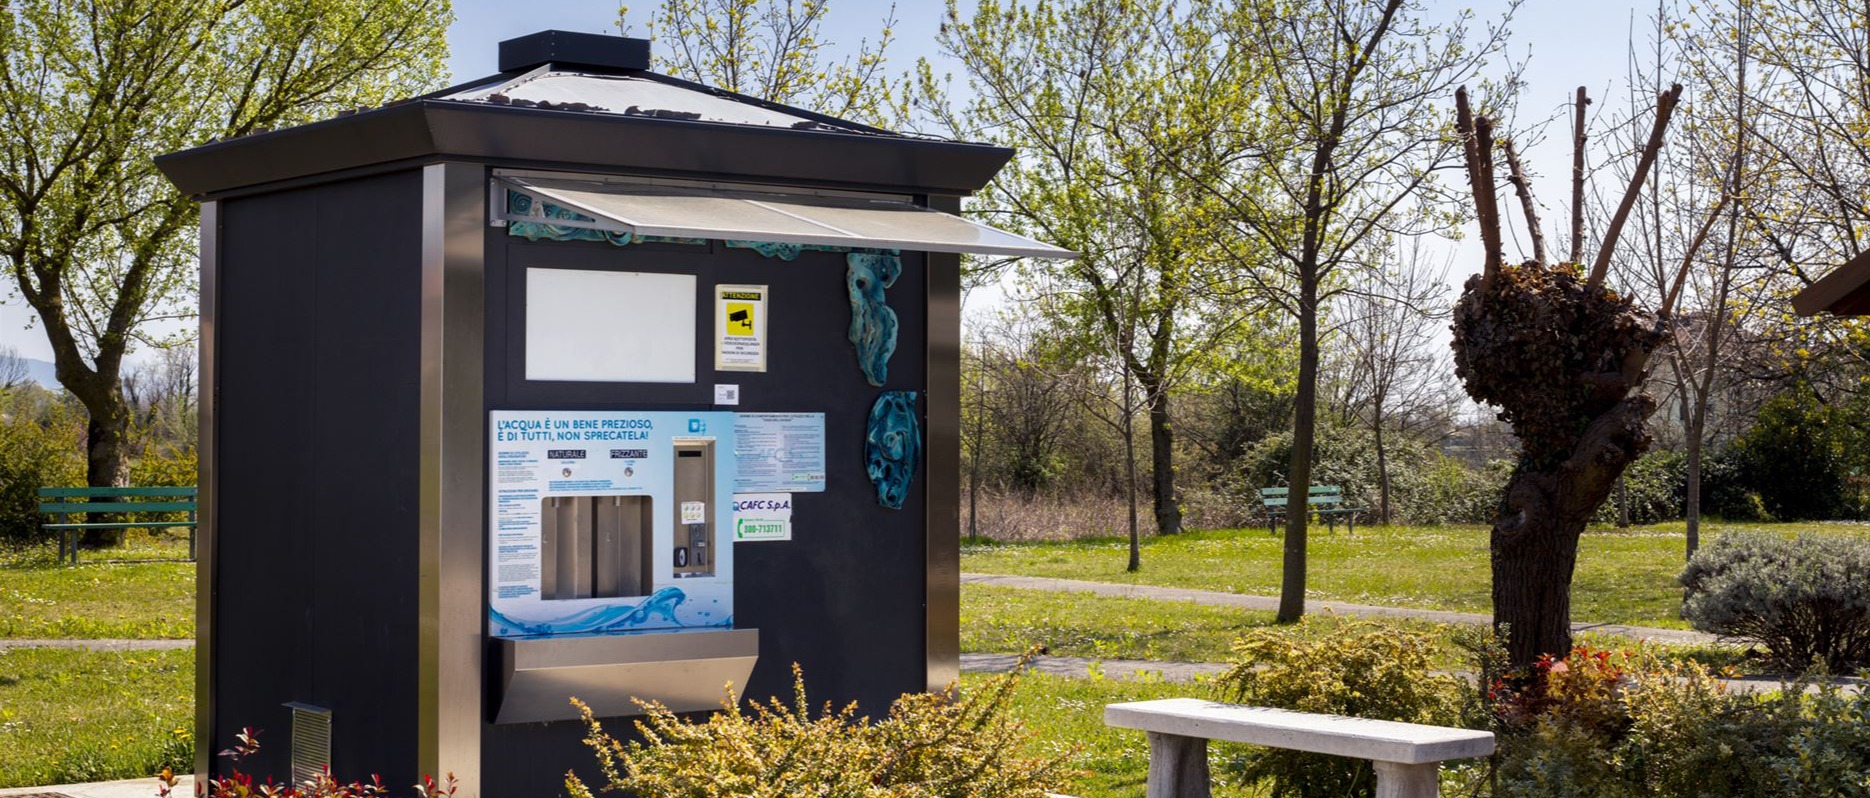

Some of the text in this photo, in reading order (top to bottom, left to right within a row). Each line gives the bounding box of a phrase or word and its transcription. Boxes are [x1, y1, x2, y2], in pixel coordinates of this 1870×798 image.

[722, 292, 760, 300] ATTENZIONE
[497, 419, 542, 431] L'ACQUA
[554, 419, 570, 429] UN
[573, 419, 599, 429] BENE
[601, 419, 653, 430] PREZIOSO,
[507, 431, 518, 441] DI
[520, 431, 555, 442] TUTTI,
[557, 431, 581, 441] NON
[584, 430, 649, 441] SPRECATELA!
[549, 450, 585, 459] NATURALE
[610, 449, 648, 458] FRIZZANTE
[740, 500, 766, 510] CAFC
